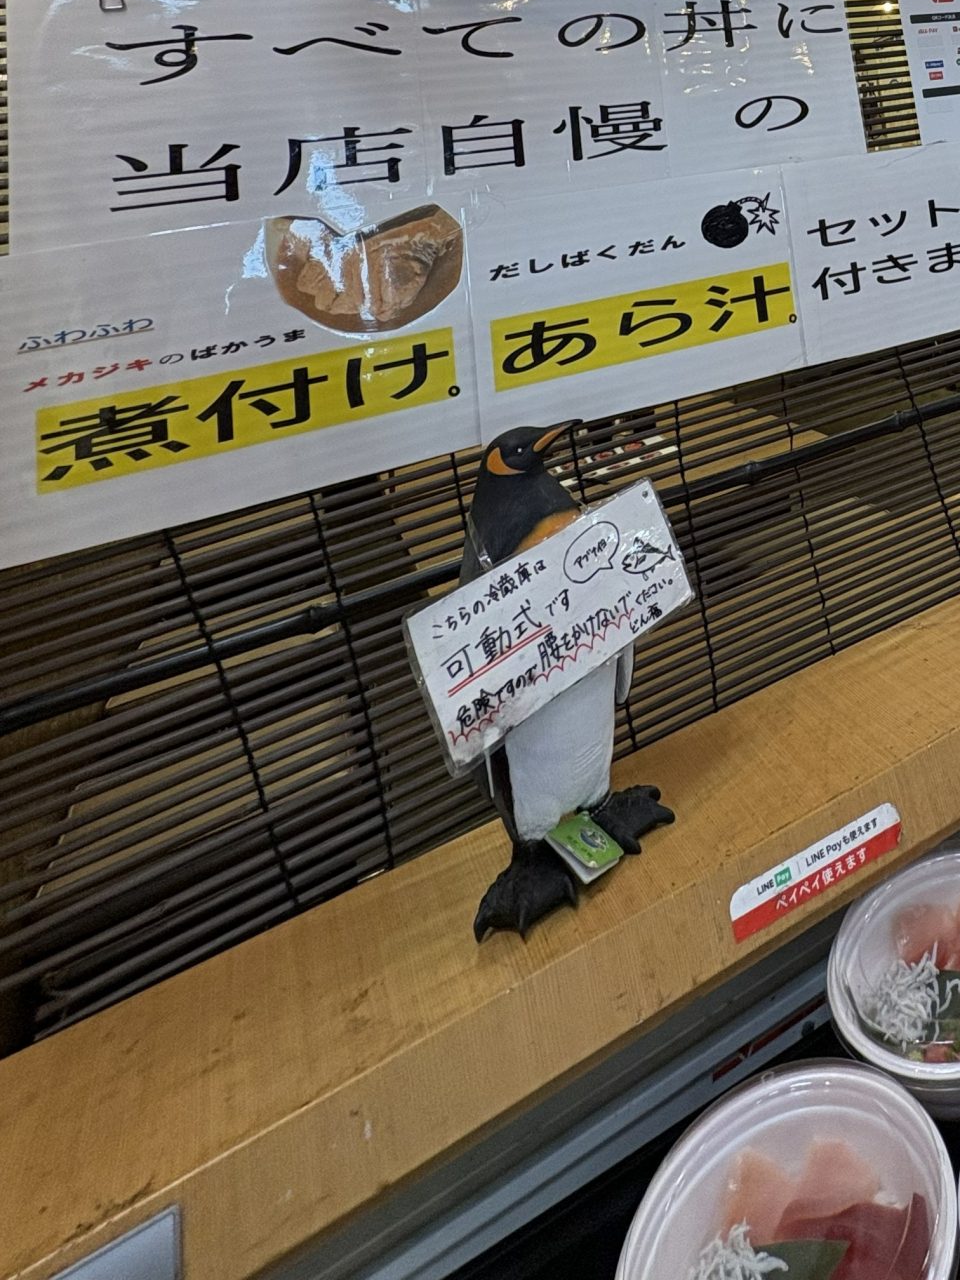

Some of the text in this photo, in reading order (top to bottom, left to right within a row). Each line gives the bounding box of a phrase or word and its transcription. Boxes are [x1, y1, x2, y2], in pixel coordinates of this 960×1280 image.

[105, 0, 845, 88] すべての丼に
[108, 94, 812, 213] 当店自慢の
[488, 236, 687, 282] だしばくだん
[19, 316, 155, 351] ふわふわ
[23, 328, 307, 394] メカジキのばかうま
[39, 340, 462, 483] 煮付け。
[431, 559, 547, 639] こちらの冷蔵庫は
[440, 589, 574, 679] 可動式です
[757, 879, 775, 896] LINE
[776, 849, 867, 910] ペイペイ使えます
